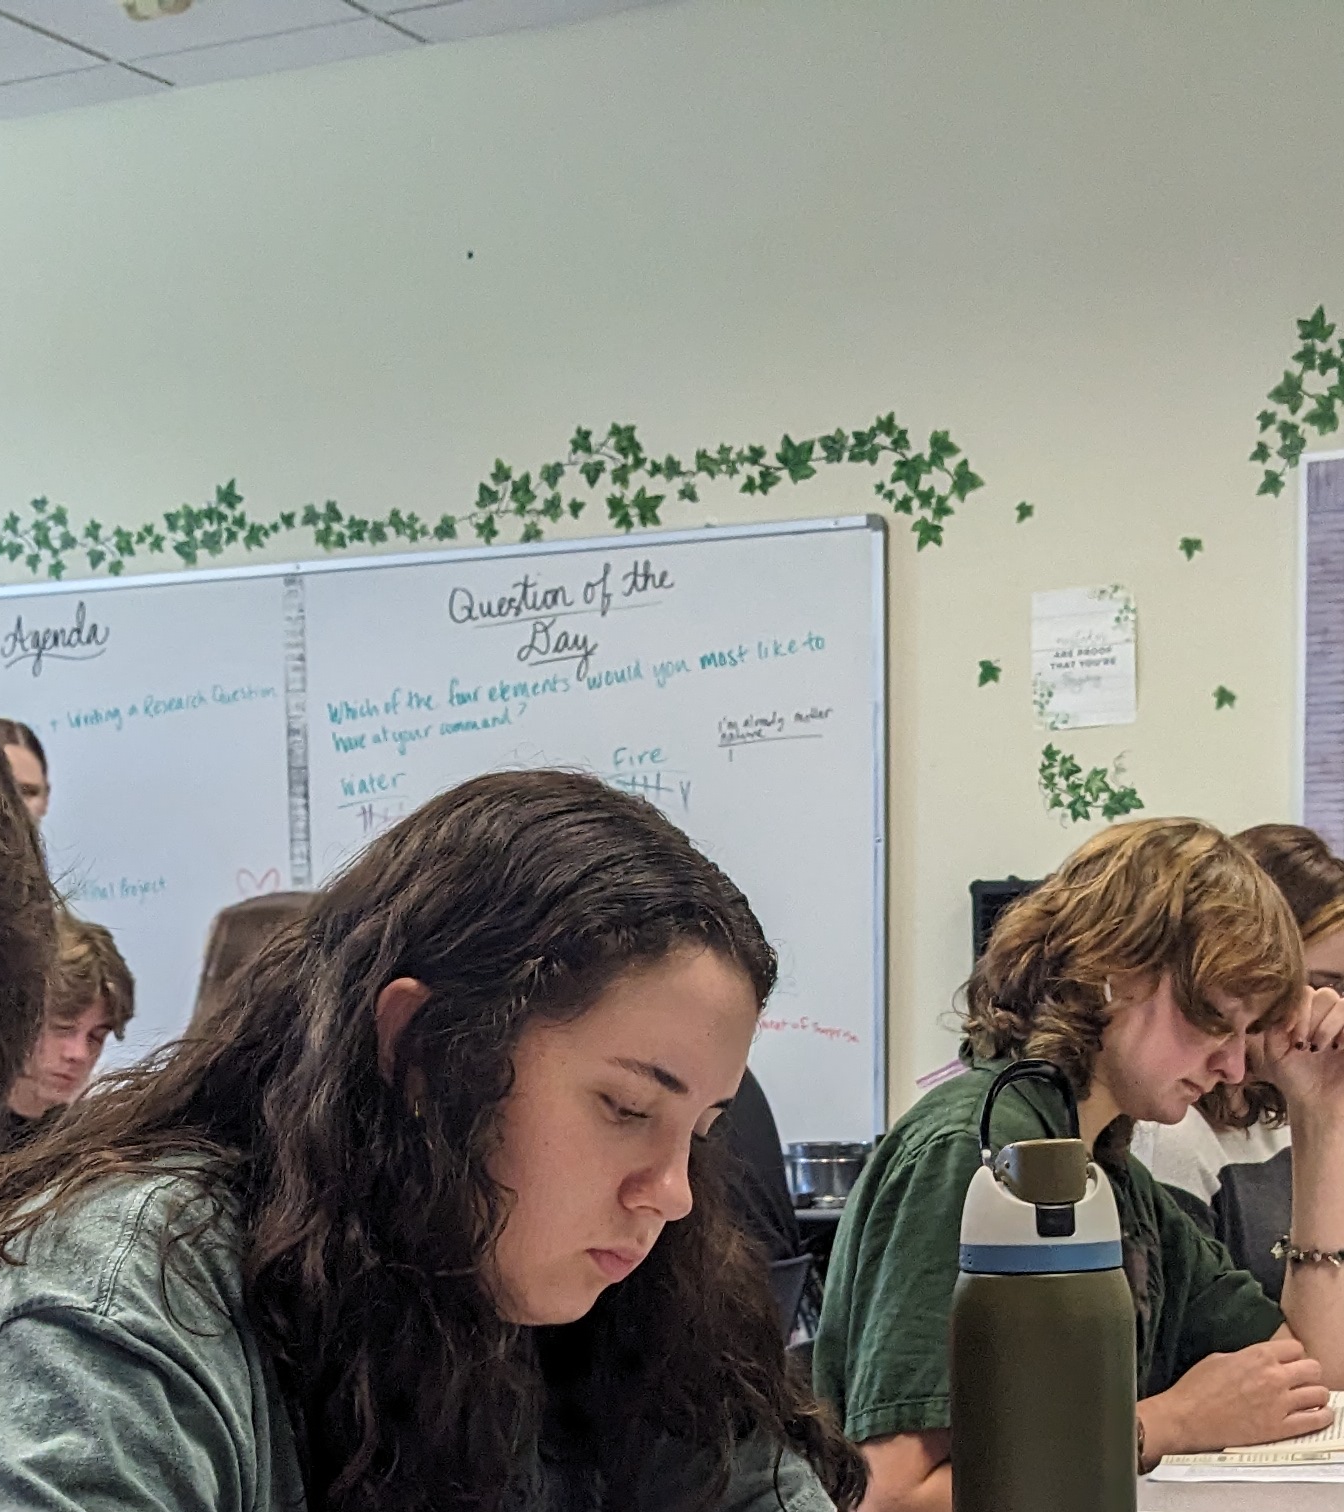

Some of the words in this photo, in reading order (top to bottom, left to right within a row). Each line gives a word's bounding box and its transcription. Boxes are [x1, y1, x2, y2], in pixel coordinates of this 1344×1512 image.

[449, 574, 574, 624] Question
[583, 563, 613, 617] of
[622, 560, 674, 598] the
[1, 601, 110, 677] Agenda
[517, 619, 599, 682] Day
[328, 698, 380, 726] Which
[384, 687, 402, 715] of
[407, 690, 434, 710] the
[488, 674, 570, 702] elements
[586, 661, 643, 691] would
[653, 660, 690, 688] you
[699, 645, 748, 670] most
[757, 639, 797, 660] like
[803, 630, 825, 650] to
[332, 731, 367, 754] have
[372, 727, 388, 744] at
[392, 725, 433, 755] your
[614, 747, 669, 768] Fire
